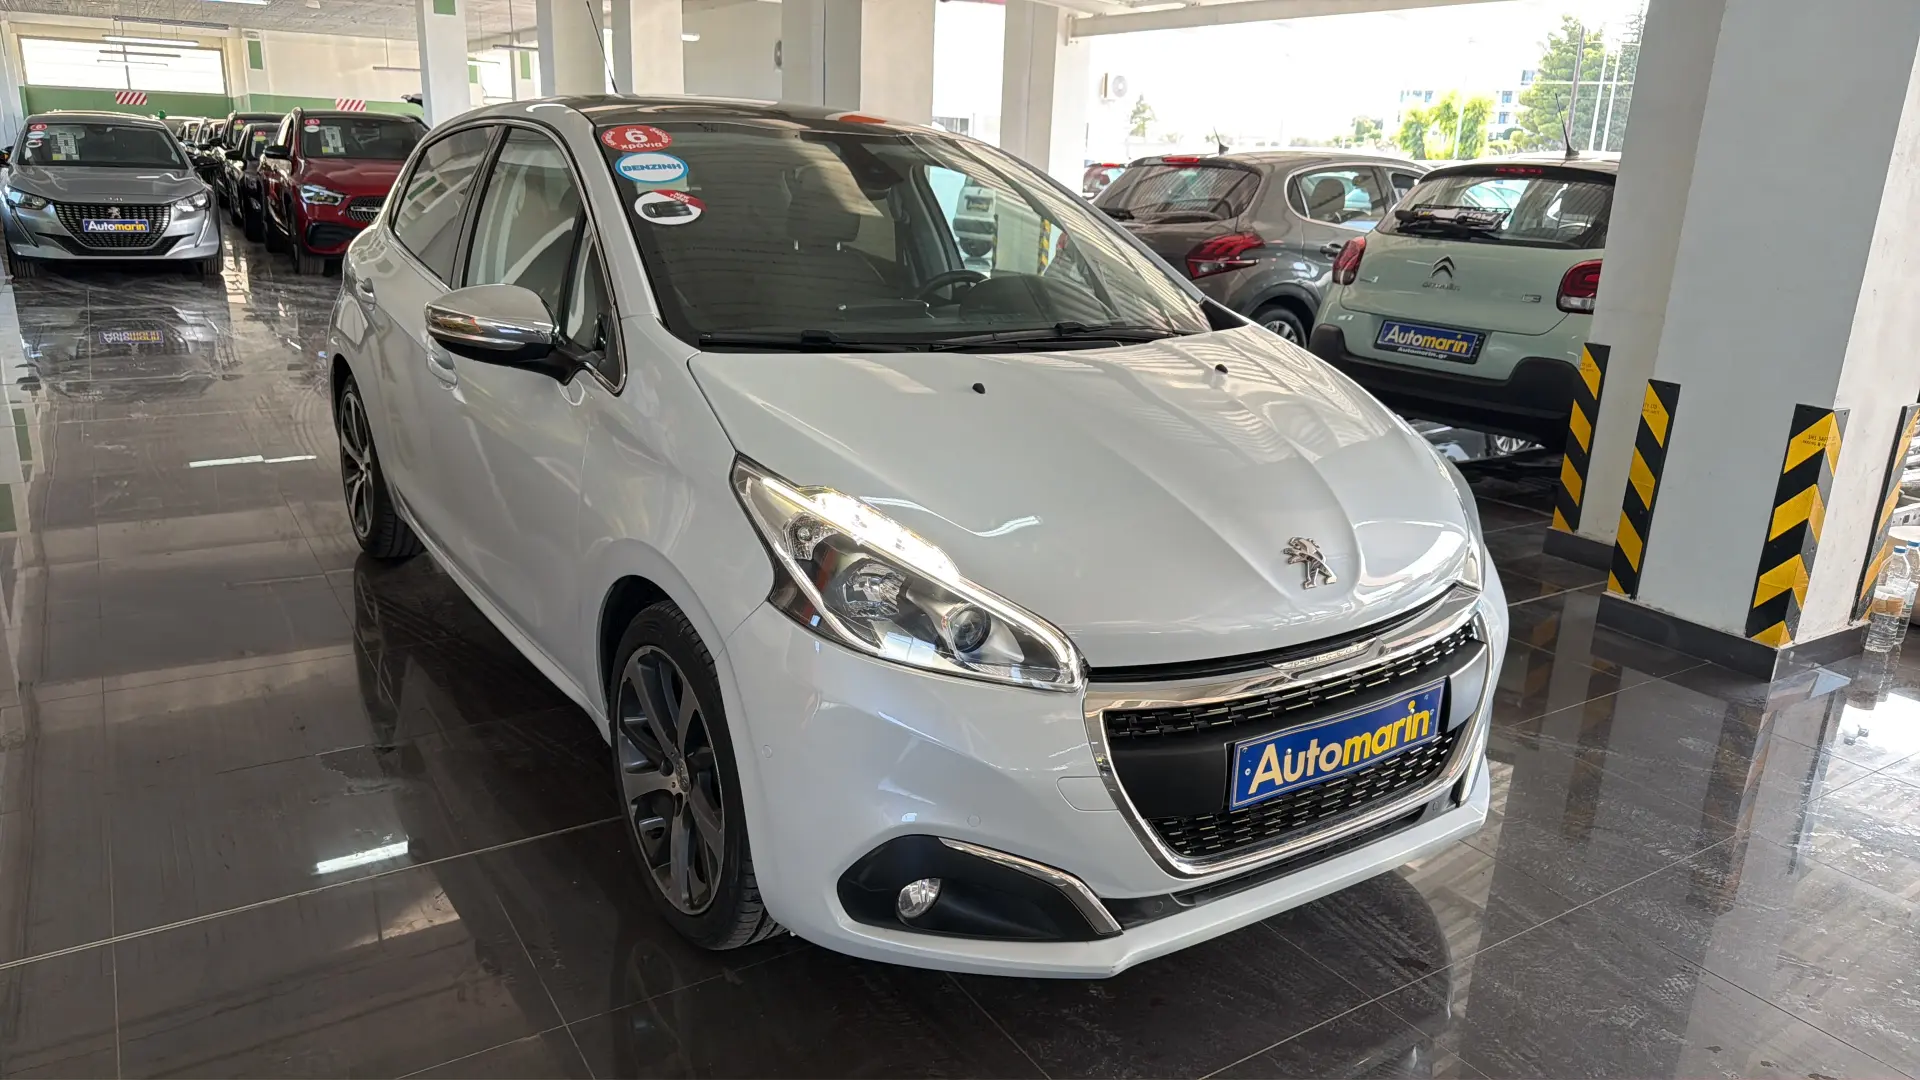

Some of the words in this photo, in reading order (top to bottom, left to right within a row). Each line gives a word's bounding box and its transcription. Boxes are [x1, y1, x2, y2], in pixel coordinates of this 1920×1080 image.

[625, 130, 648, 144] 6
[88, 220, 146, 231] Automarin
[1384, 325, 1468, 353] Automarin
[1397, 346, 1448, 359] Automarin.gr
[1247, 699, 1431, 795] Automarin
